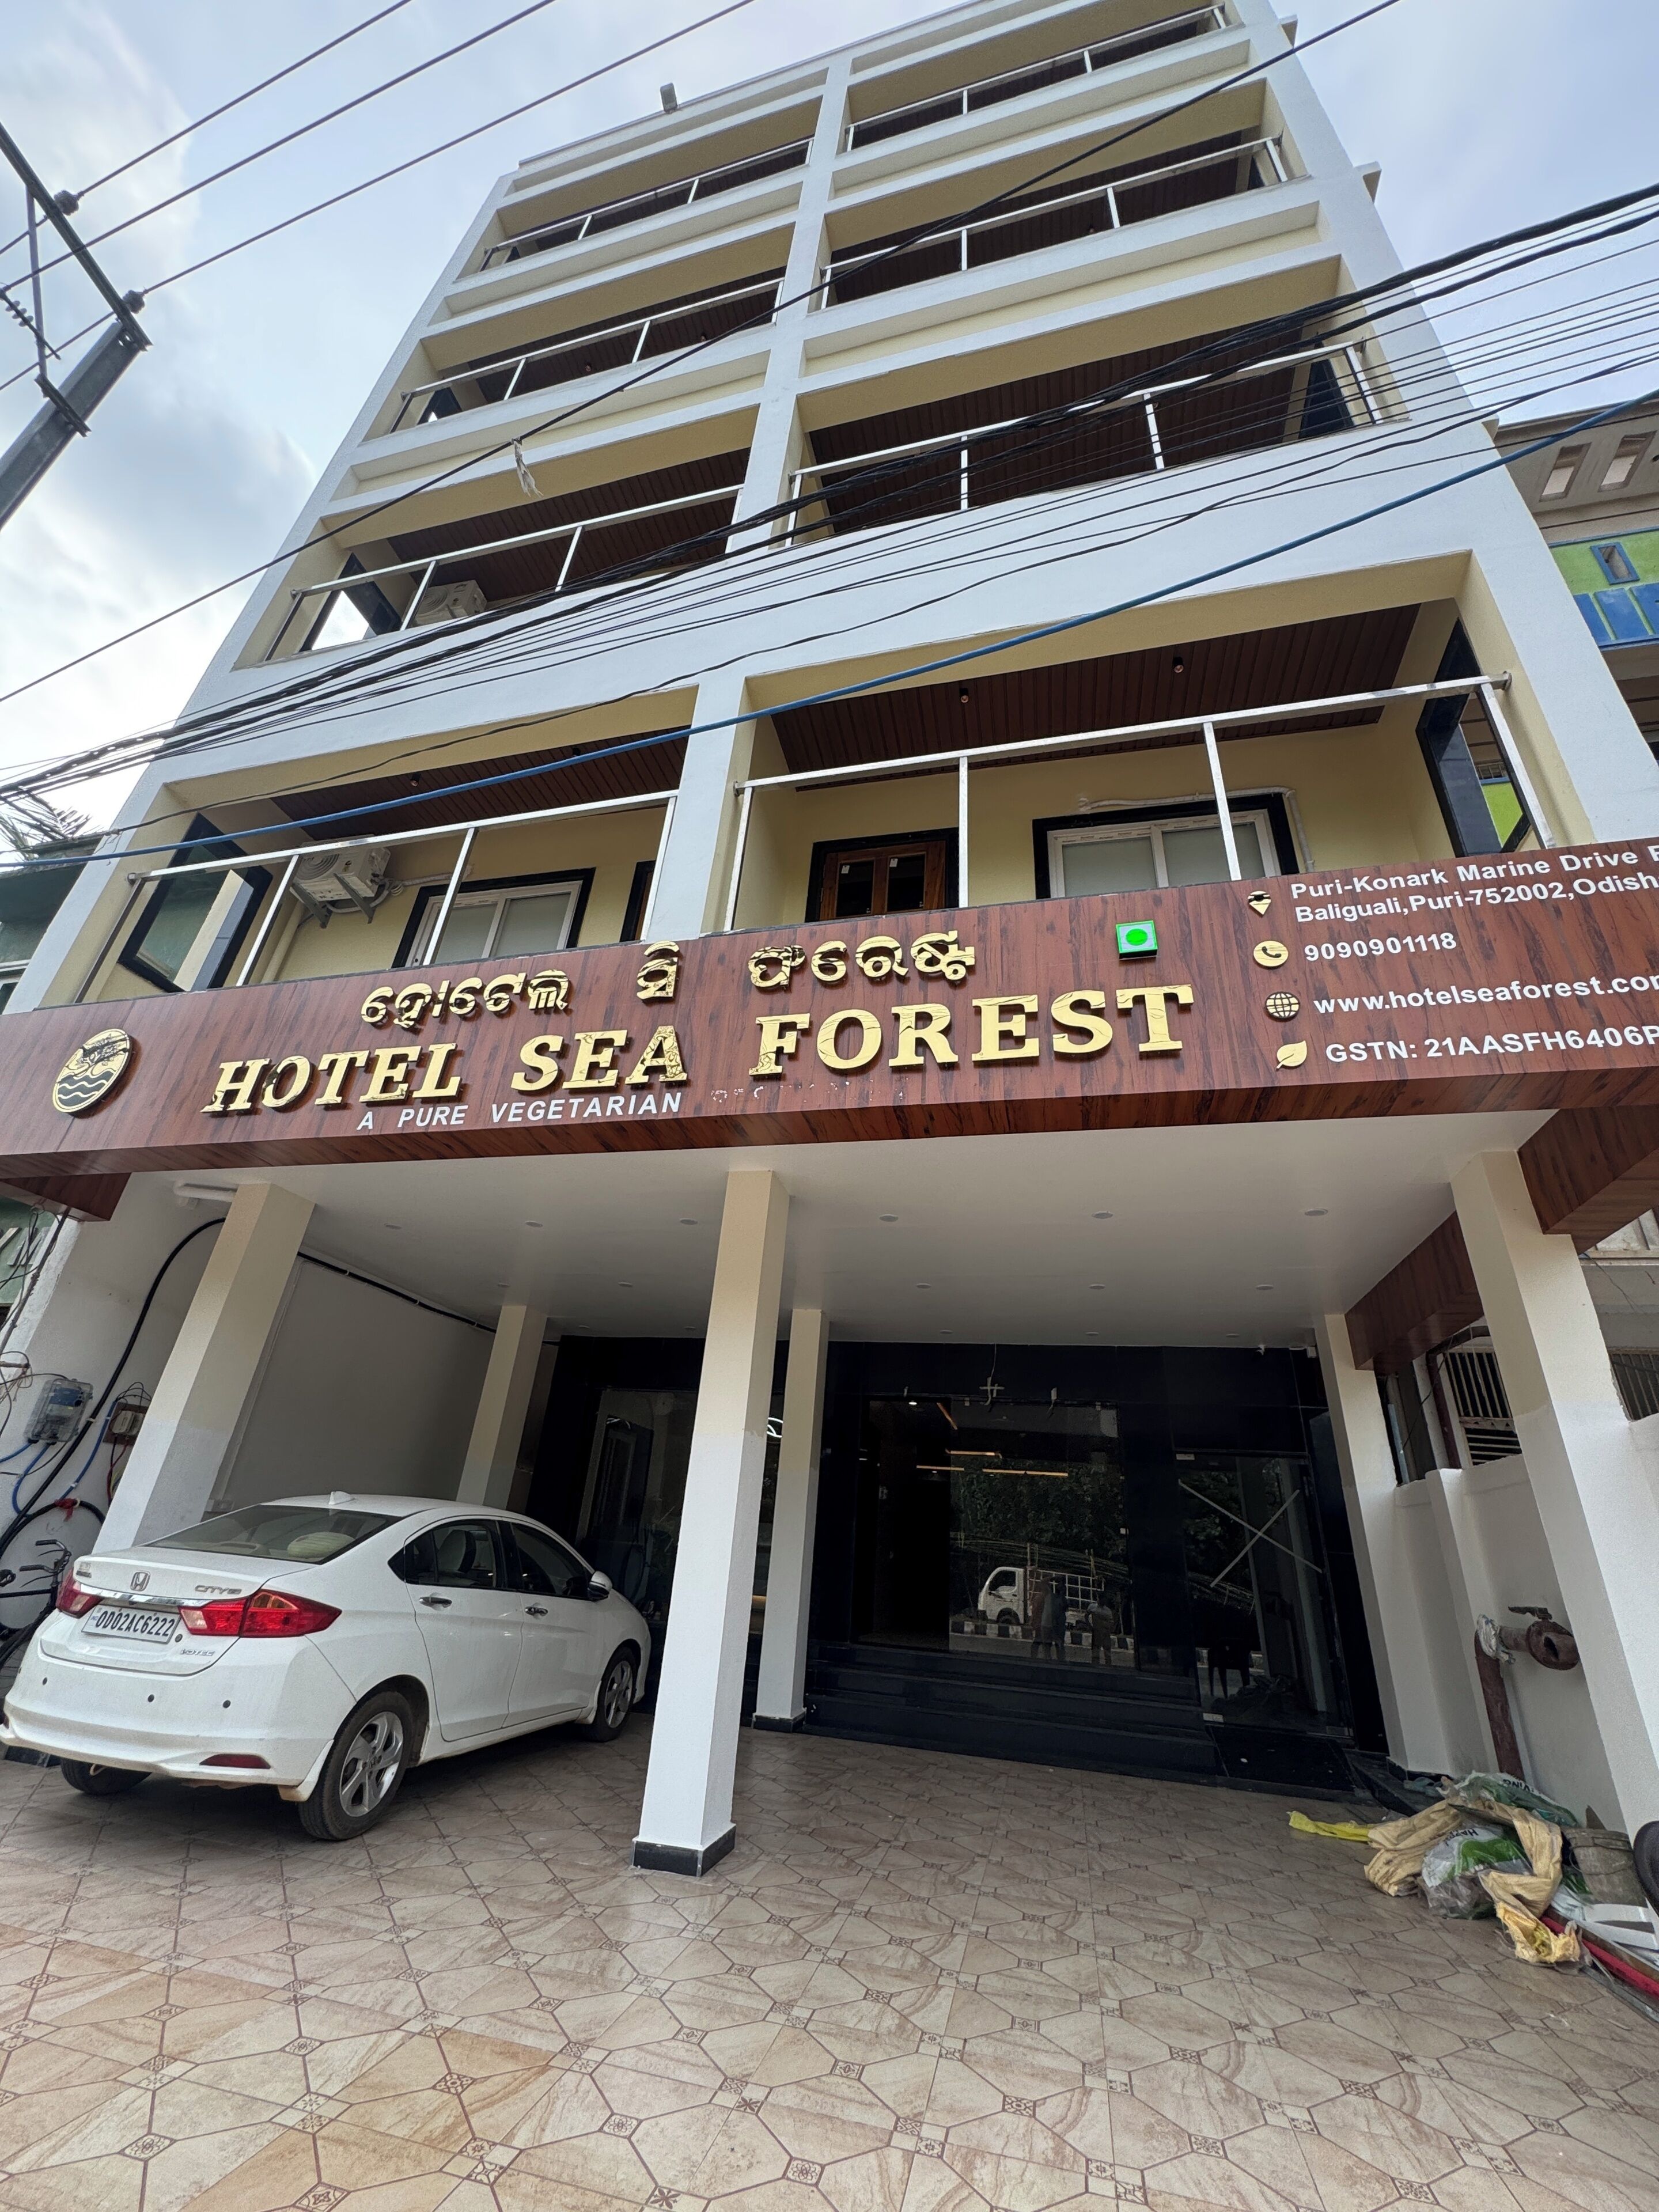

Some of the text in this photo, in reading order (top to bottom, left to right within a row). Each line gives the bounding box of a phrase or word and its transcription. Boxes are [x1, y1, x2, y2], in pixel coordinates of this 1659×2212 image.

[1290, 869, 1449, 899] Puri-Konark
[1456, 861, 1551, 882] Marine
[1559, 852, 1638, 872] Drive
[1304, 932, 1457, 961] 9090901118
[200, 984, 1194, 1113] HOTEL SEA FOREST
[1325, 1039, 1418, 1063] GSTN:
[356, 1111, 374, 1131] A
[397, 1105, 469, 1128] PURE
[491, 1092, 682, 1123] VEGETARIAN
